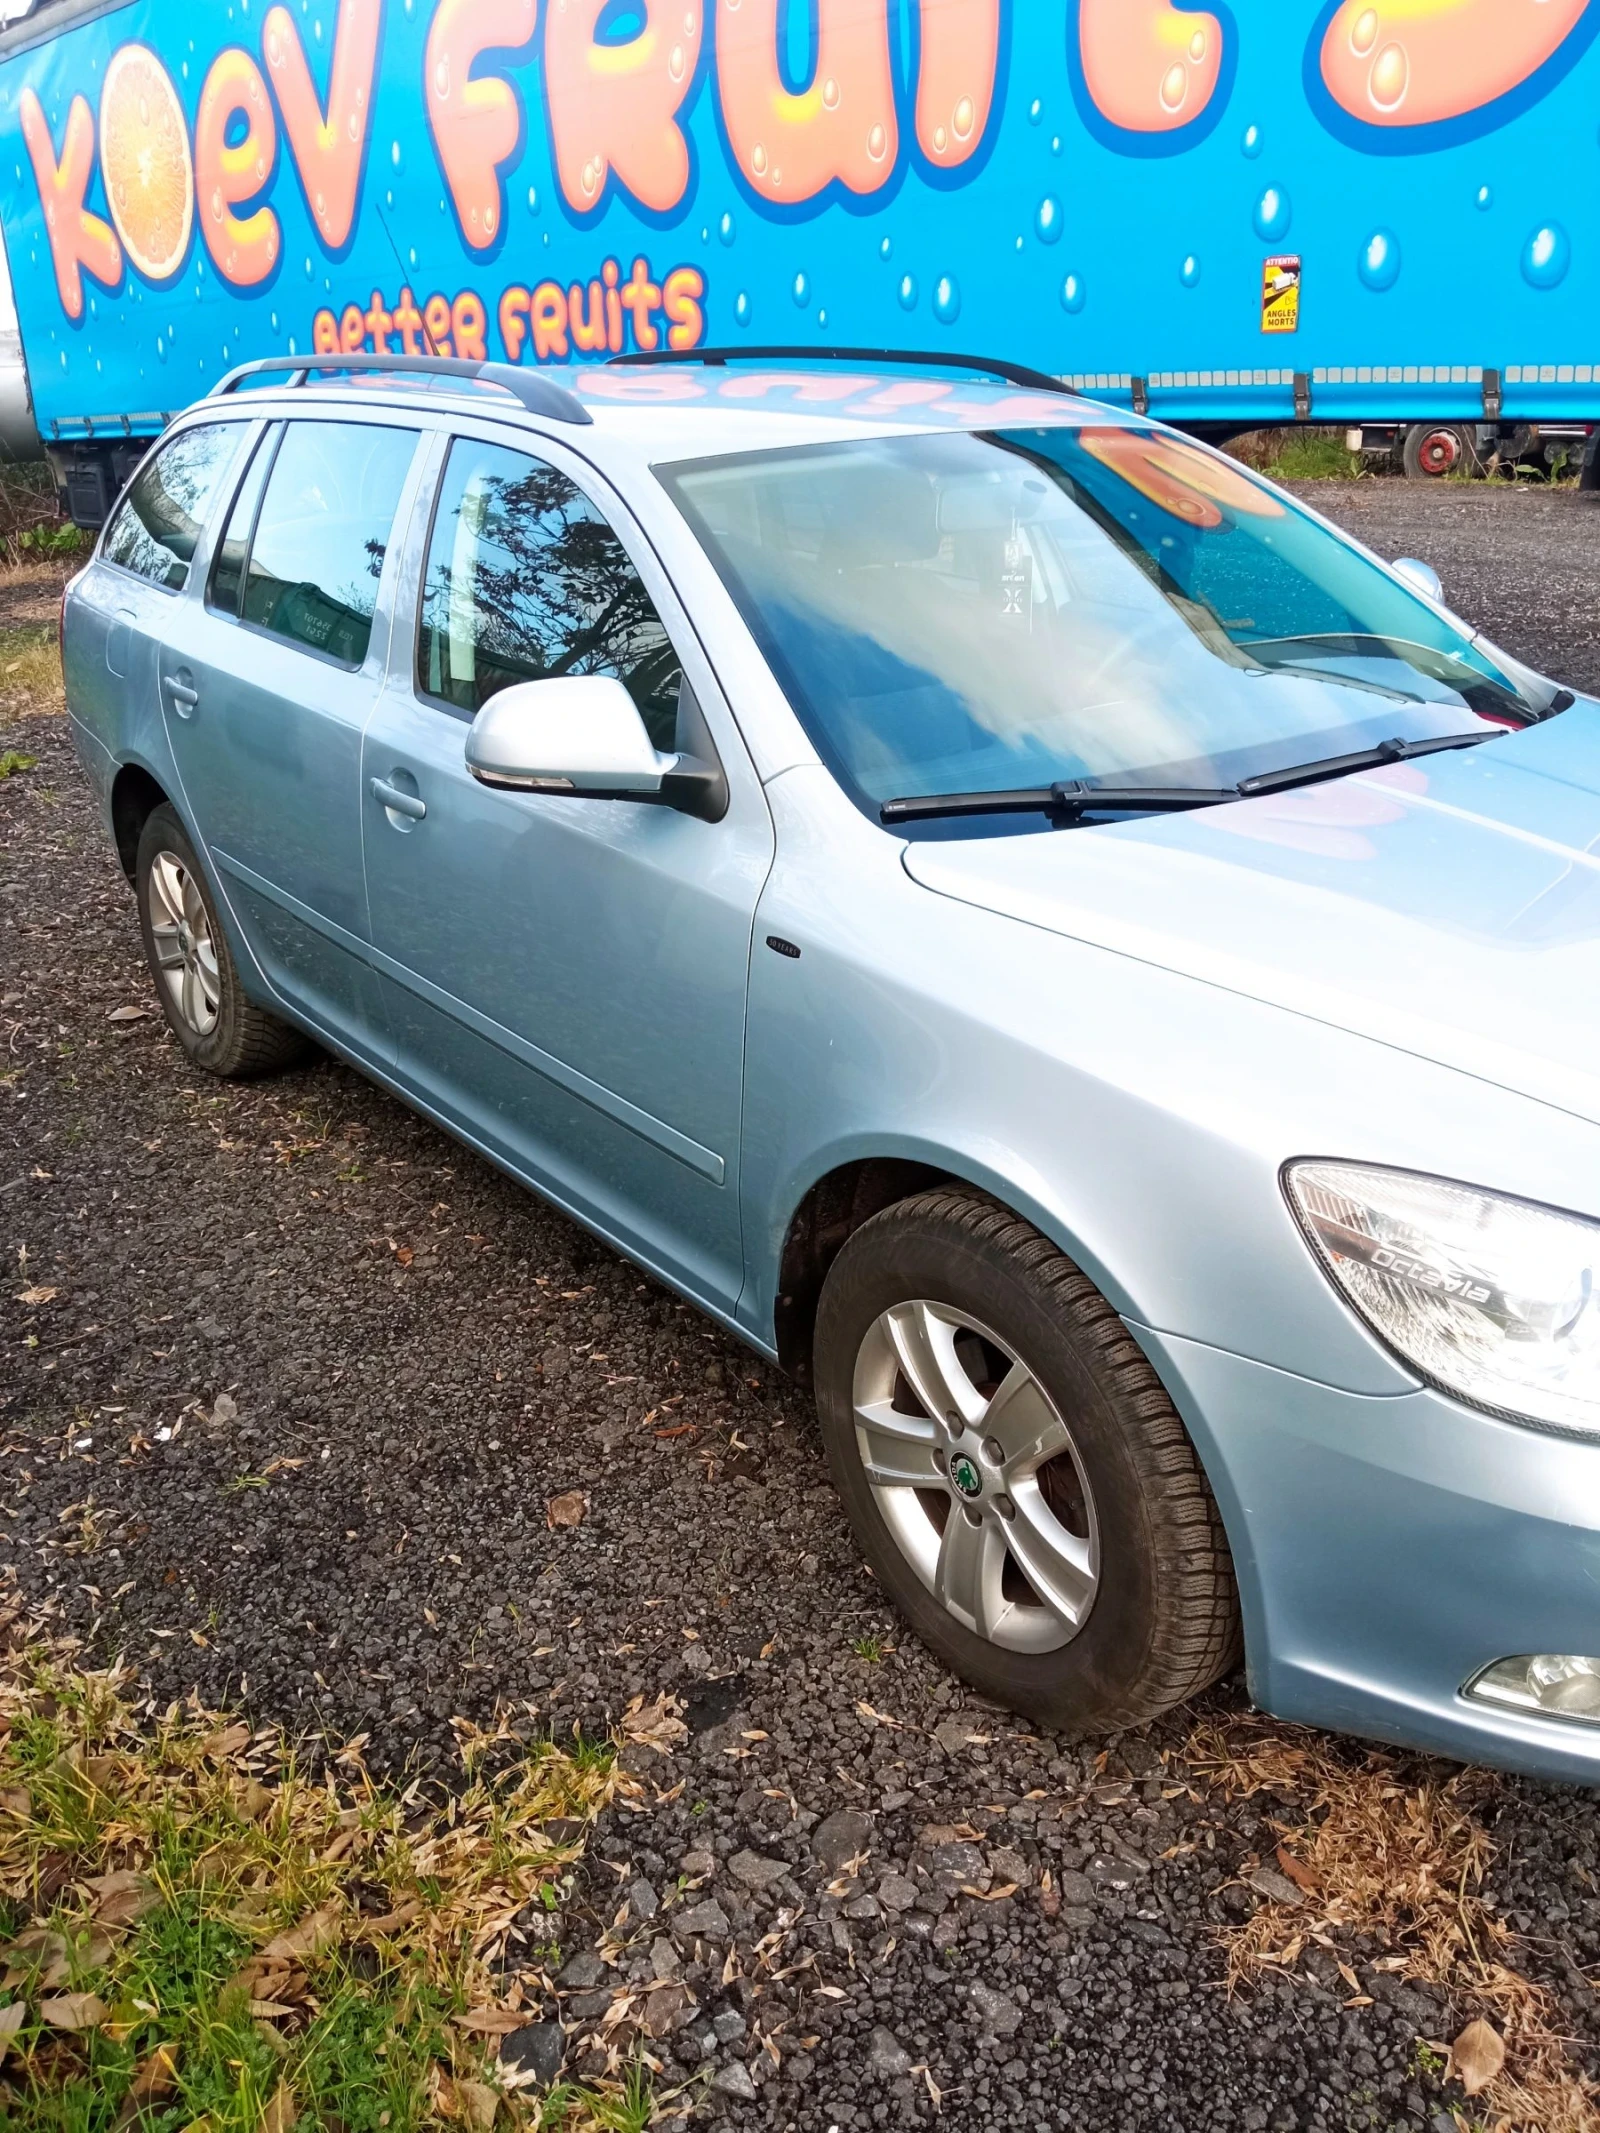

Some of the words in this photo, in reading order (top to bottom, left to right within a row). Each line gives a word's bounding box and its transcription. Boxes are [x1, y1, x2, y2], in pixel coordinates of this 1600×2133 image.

[1266, 256, 1299, 266] ATTENTIO
[1267, 309, 1296, 318] ANGLES
[1268, 318, 1294, 326] MORTS
